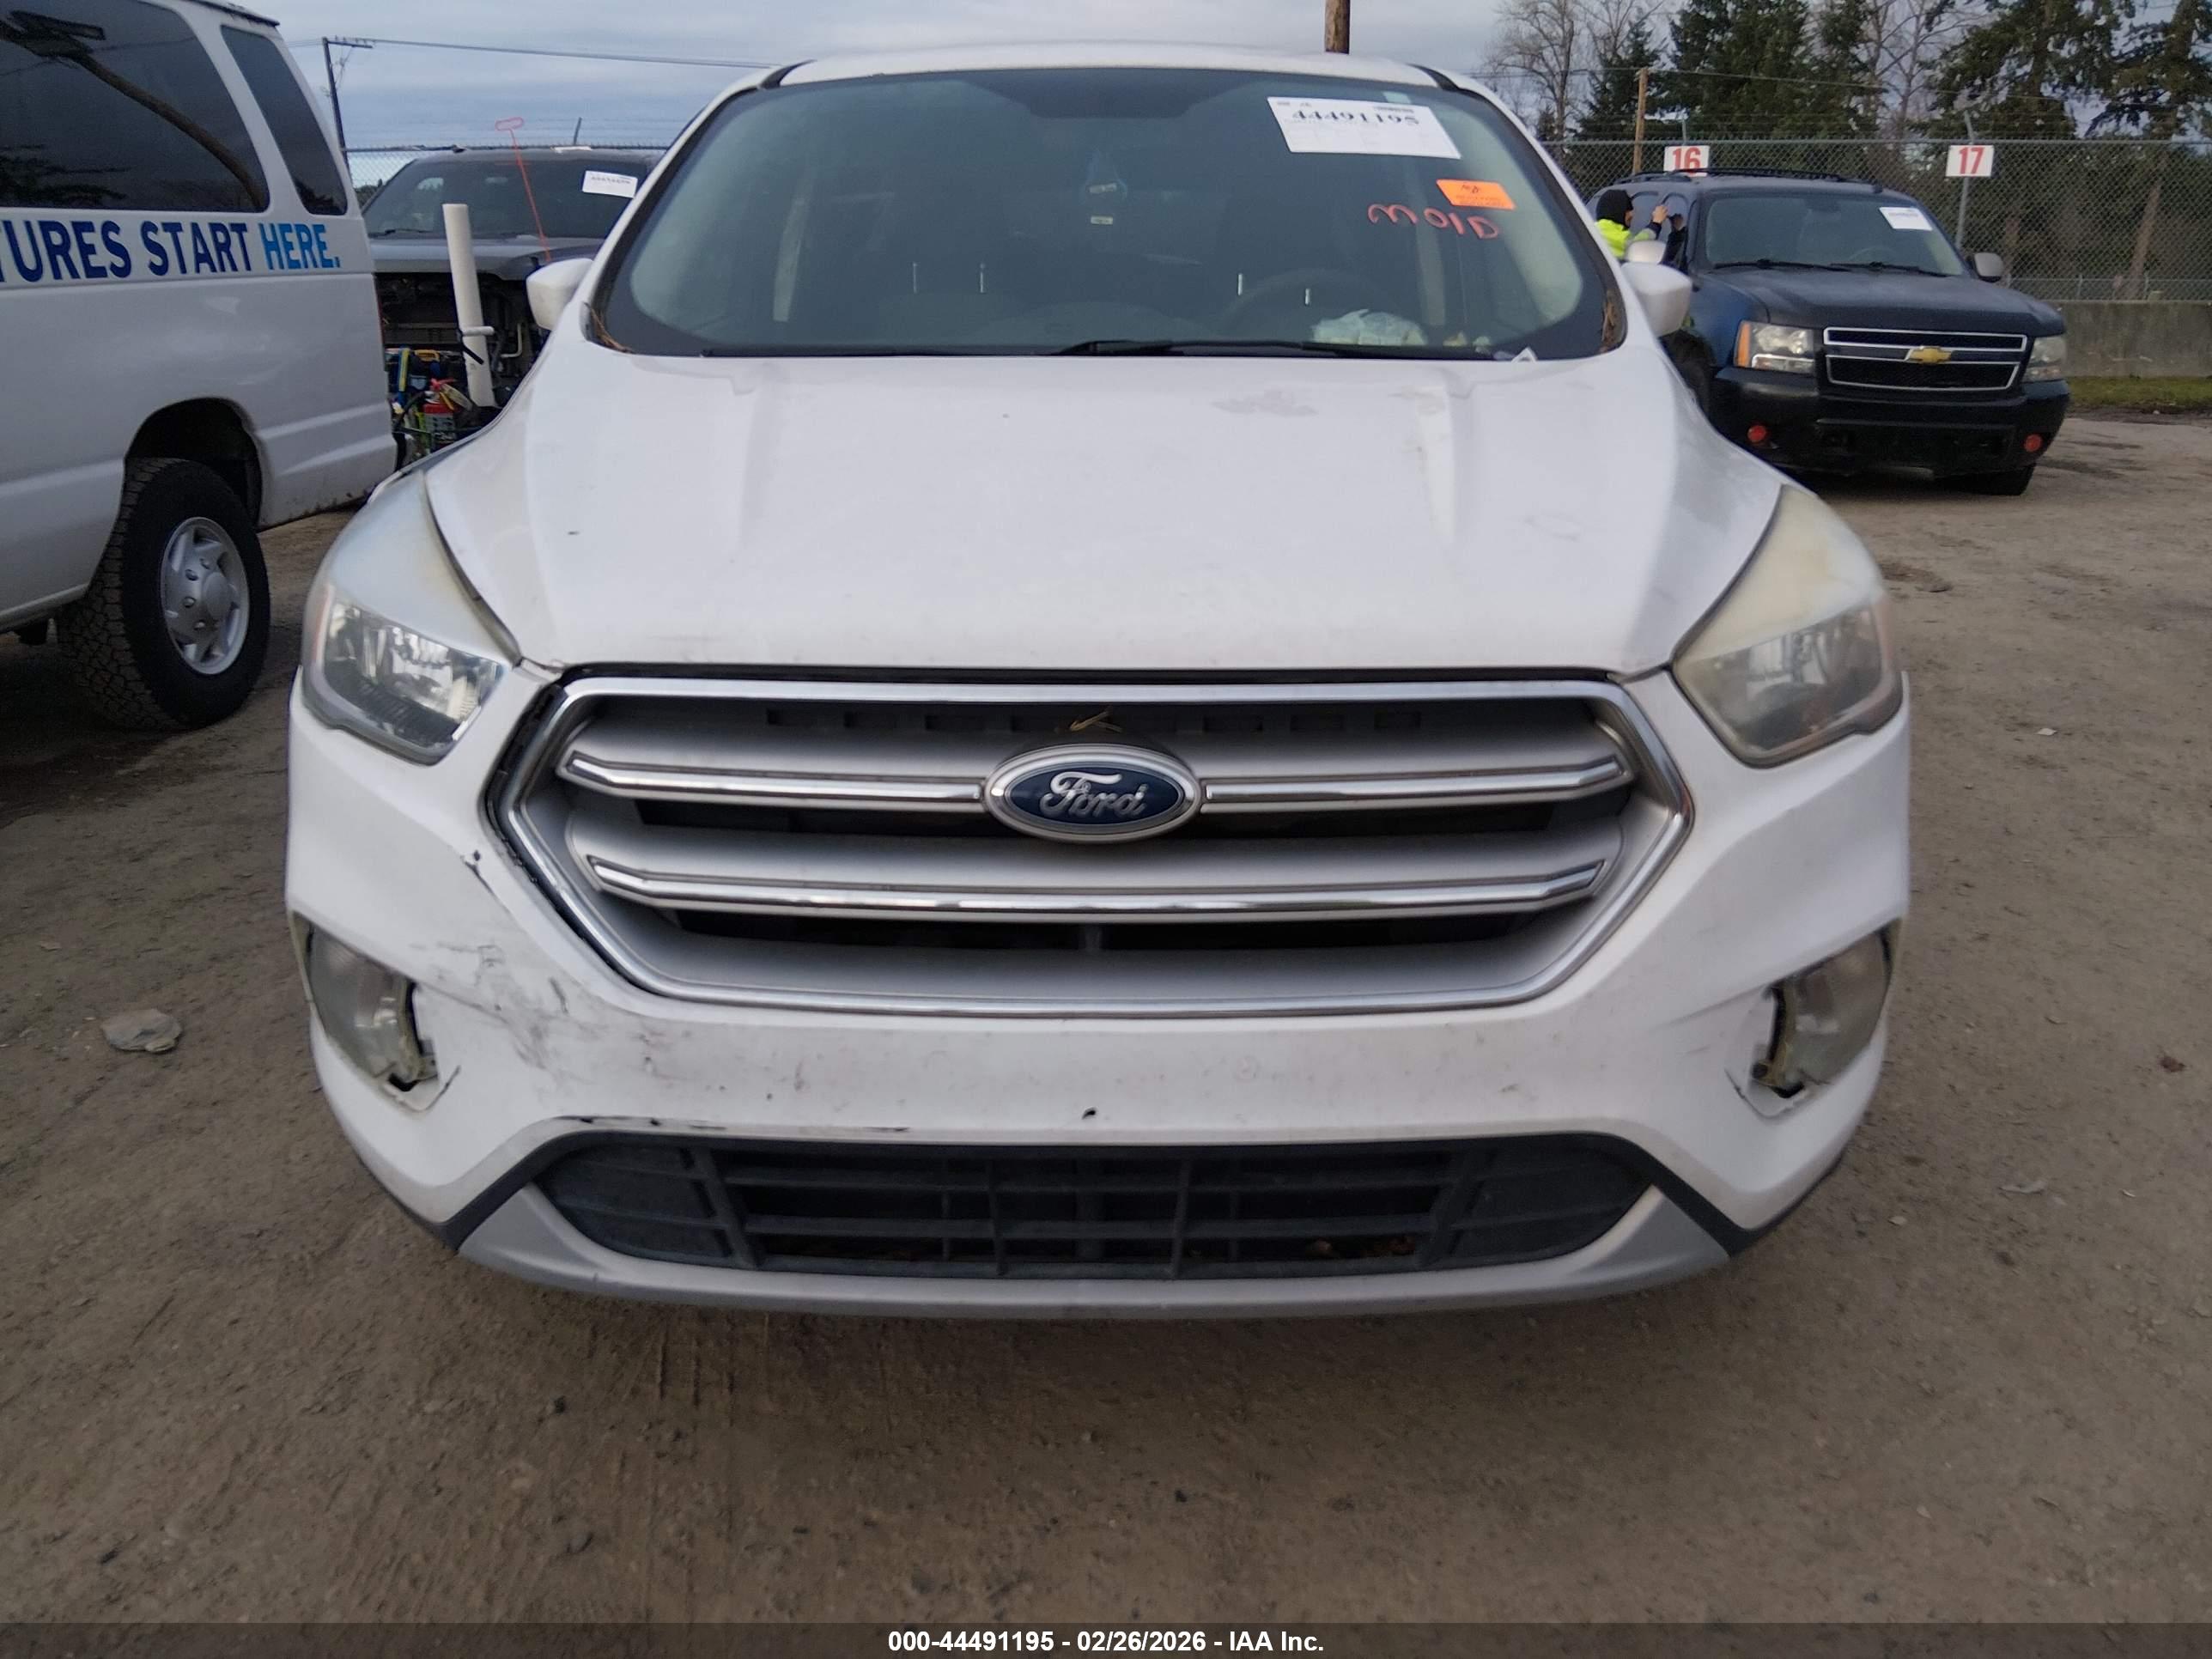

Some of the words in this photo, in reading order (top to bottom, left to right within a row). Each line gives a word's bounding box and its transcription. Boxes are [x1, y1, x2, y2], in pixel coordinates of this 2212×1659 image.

[1672, 147, 1701, 175] 16
[1959, 146, 1984, 174] 17
[0, 219, 132, 283] URES
[140, 220, 252, 276] START
[258, 222, 341, 270] HERE.
[1039, 771, 1149, 817] Ford
